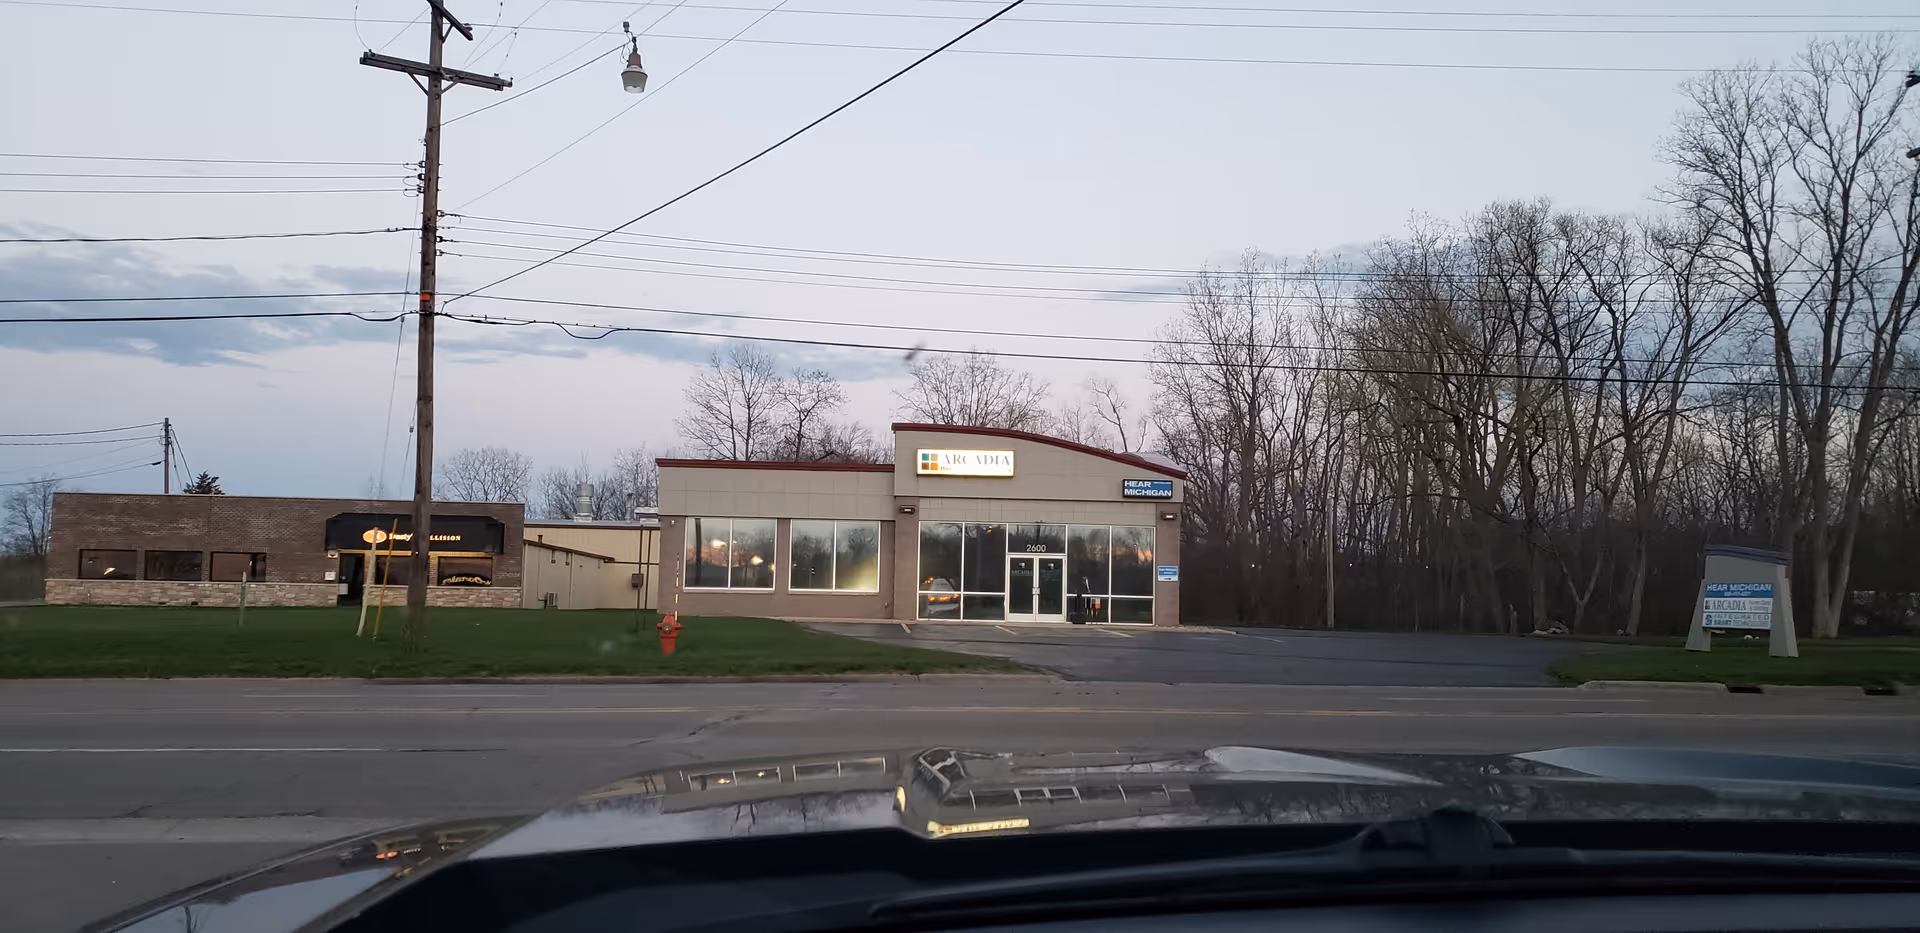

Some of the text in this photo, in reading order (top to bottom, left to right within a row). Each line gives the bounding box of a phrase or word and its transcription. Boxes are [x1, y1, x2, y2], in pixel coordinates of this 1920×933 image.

[943, 453, 1010, 466] ARCADIA
[1124, 480, 1152, 488] HEAR
[1124, 488, 1172, 497] MICHIGAN
[1026, 544, 1047, 552] 2600
[1706, 583, 1772, 592] HEAR MICHIGAN
[1711, 599, 1747, 611] ARCADIA
[1713, 613, 1770, 621] INTEGRATED
